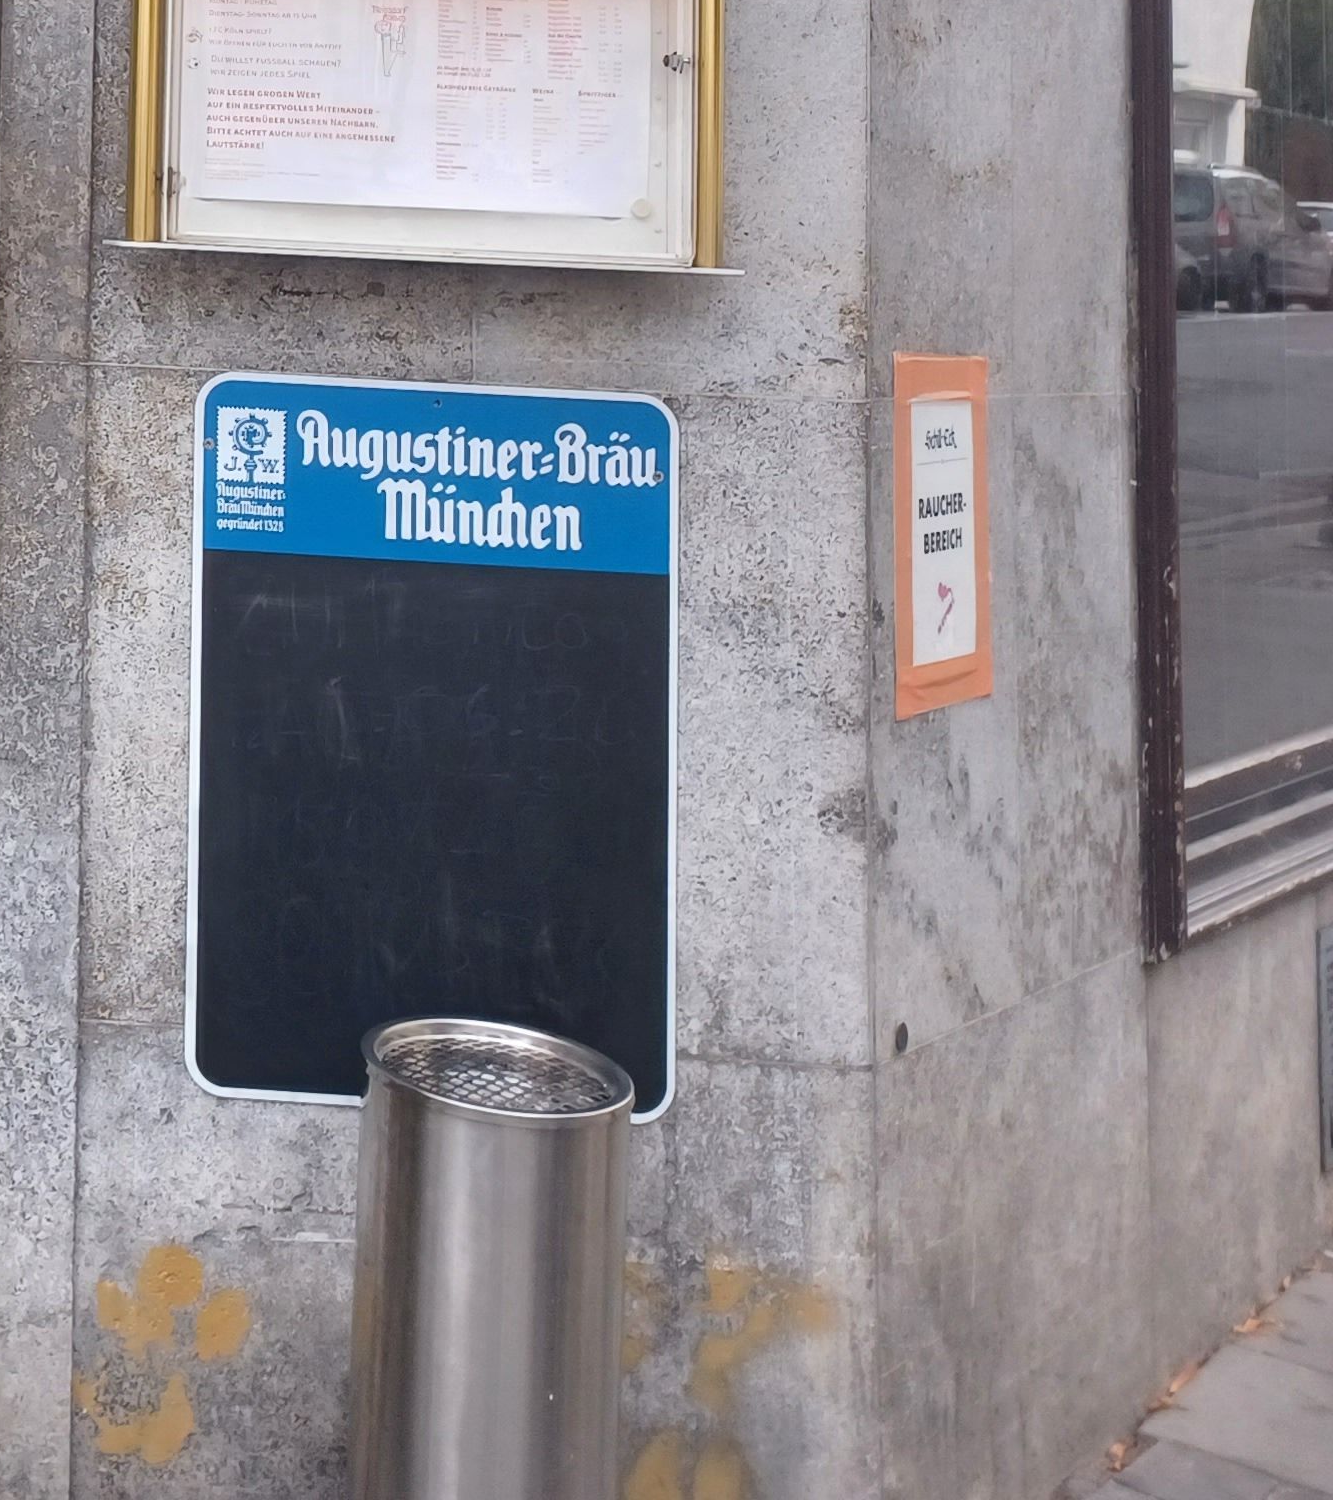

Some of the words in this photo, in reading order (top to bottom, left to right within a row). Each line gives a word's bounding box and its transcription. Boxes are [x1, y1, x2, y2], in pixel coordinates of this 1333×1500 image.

[296, 409, 658, 488] Augustiner-Bräu
[377, 477, 582, 551] München
[918, 492, 967, 520] RAUCHER-
[264, 519, 284, 533] 1328
[923, 526, 963, 555] BEREICH
